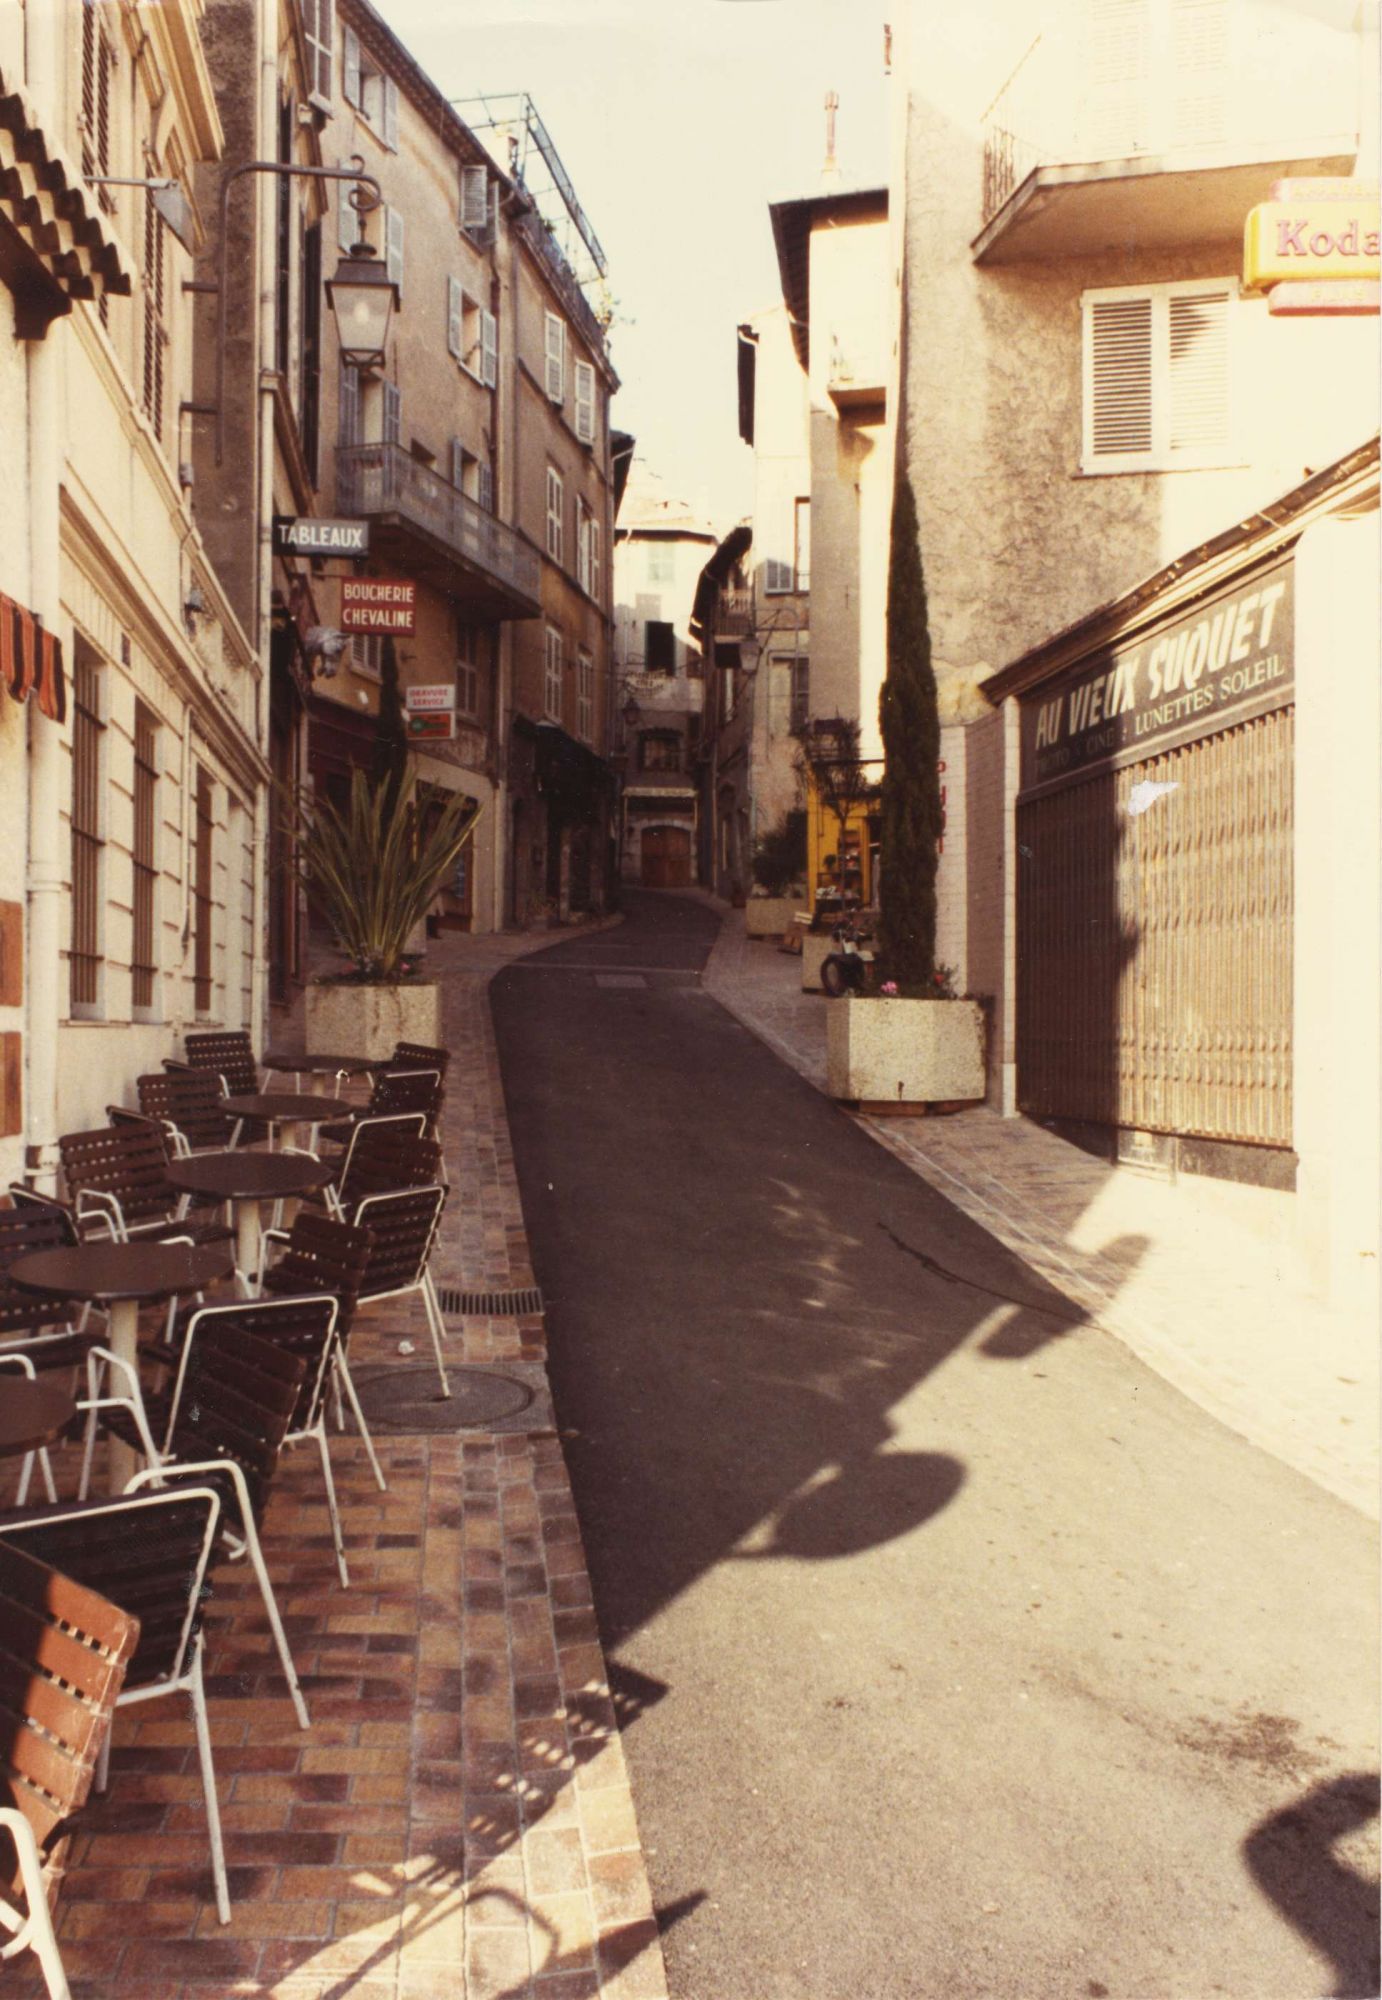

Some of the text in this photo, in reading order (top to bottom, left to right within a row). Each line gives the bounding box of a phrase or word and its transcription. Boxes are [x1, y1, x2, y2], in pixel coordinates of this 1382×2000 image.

[279, 525, 362, 548] TABLEAUX
[343, 584, 414, 602] BOUCHERIE
[342, 608, 413, 628] CHEVALINE
[1036, 581, 1285, 750] AU VIEUX SUQUET
[1135, 684, 1213, 736] LUNETTES
[1221, 654, 1285, 699] SOLEIL
